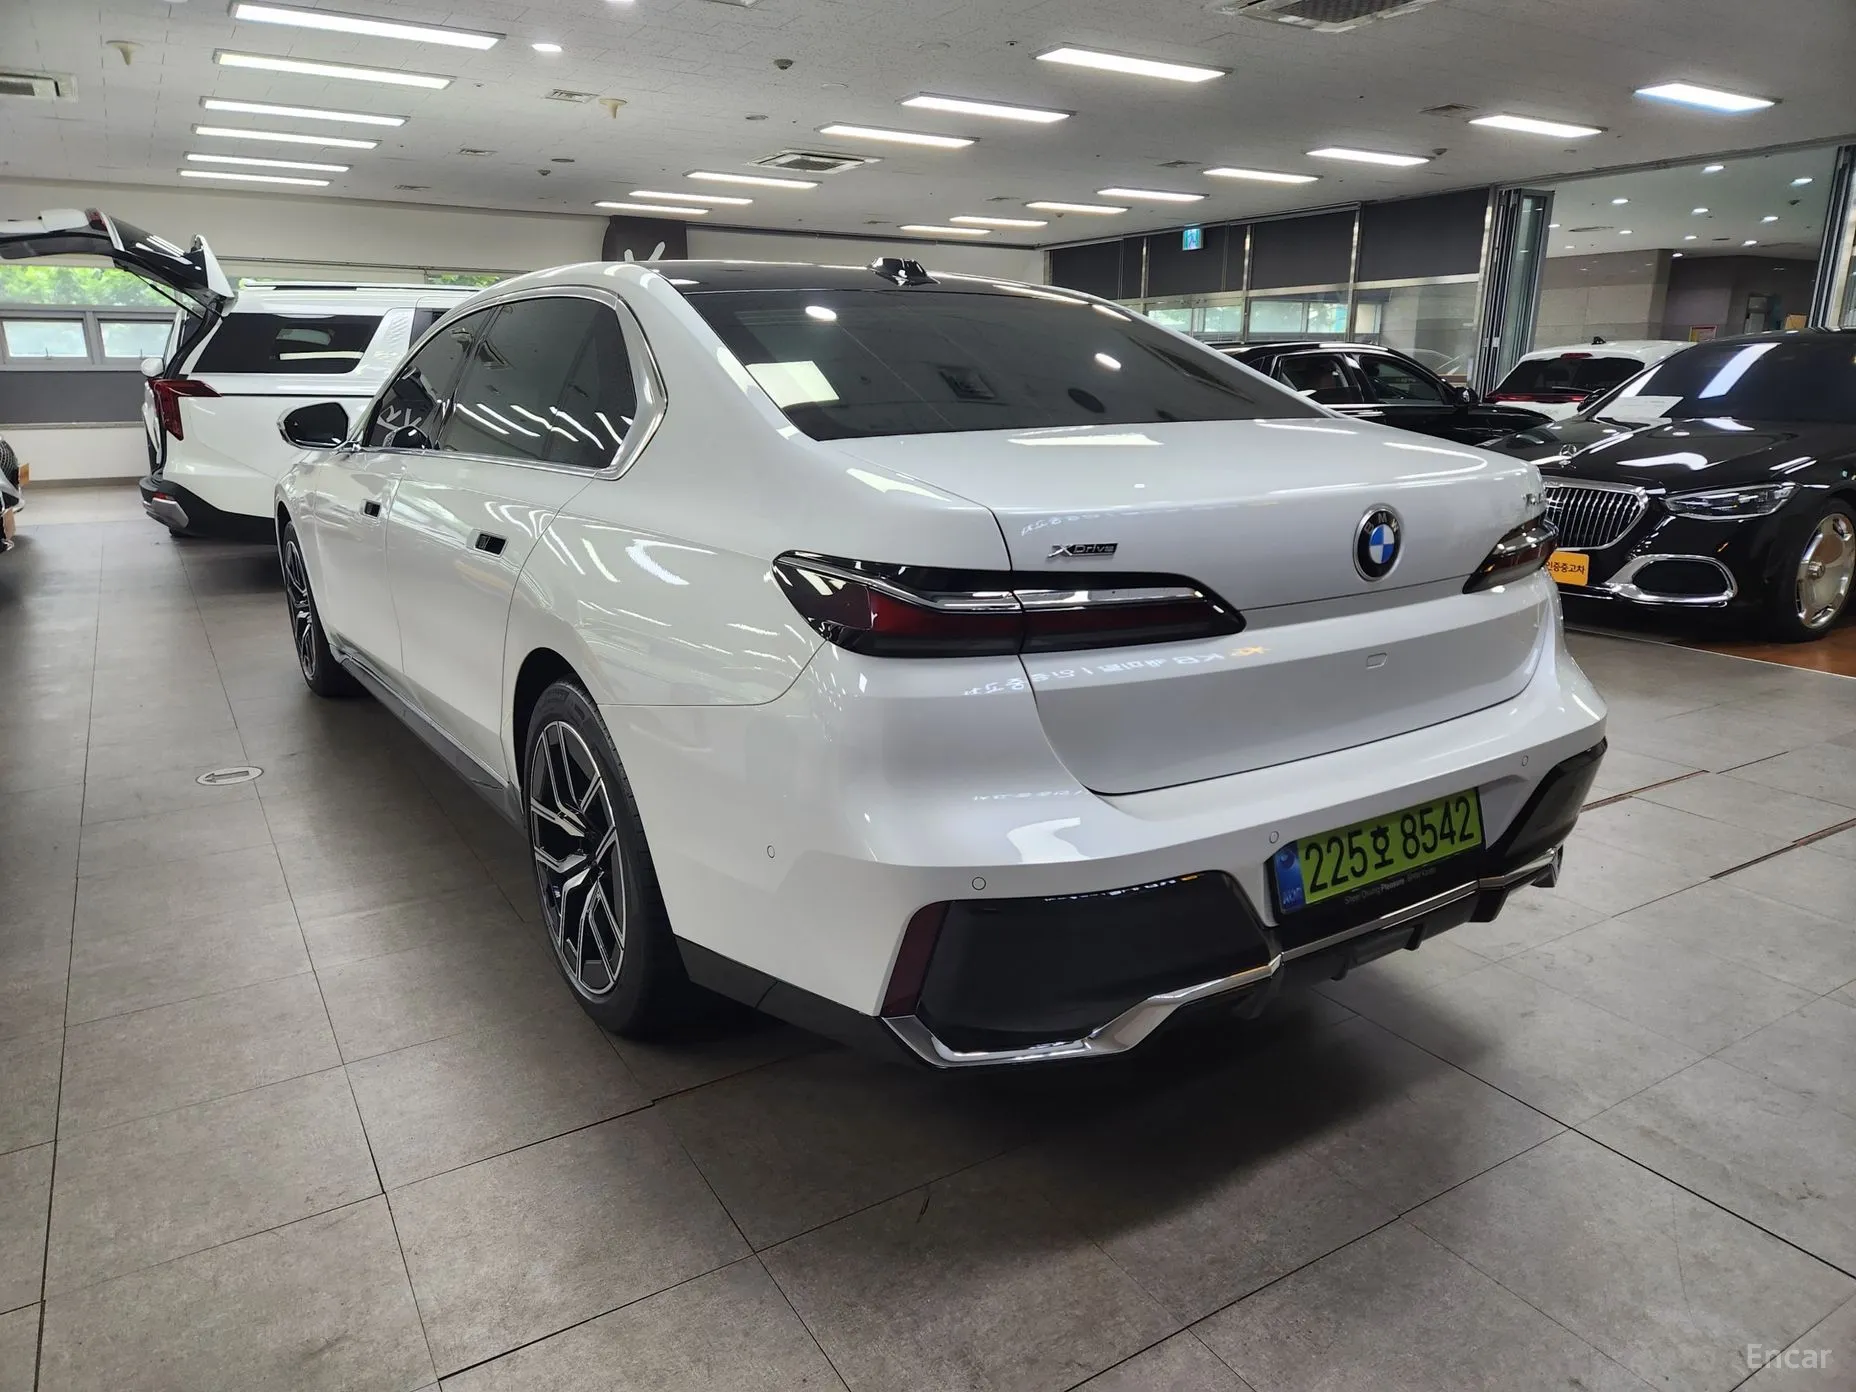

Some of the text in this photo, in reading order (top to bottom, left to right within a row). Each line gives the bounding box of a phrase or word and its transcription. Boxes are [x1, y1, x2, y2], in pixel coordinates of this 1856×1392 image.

[1363, 511, 1400, 535] BMW
[1305, 796, 1474, 894] 225호 8542
